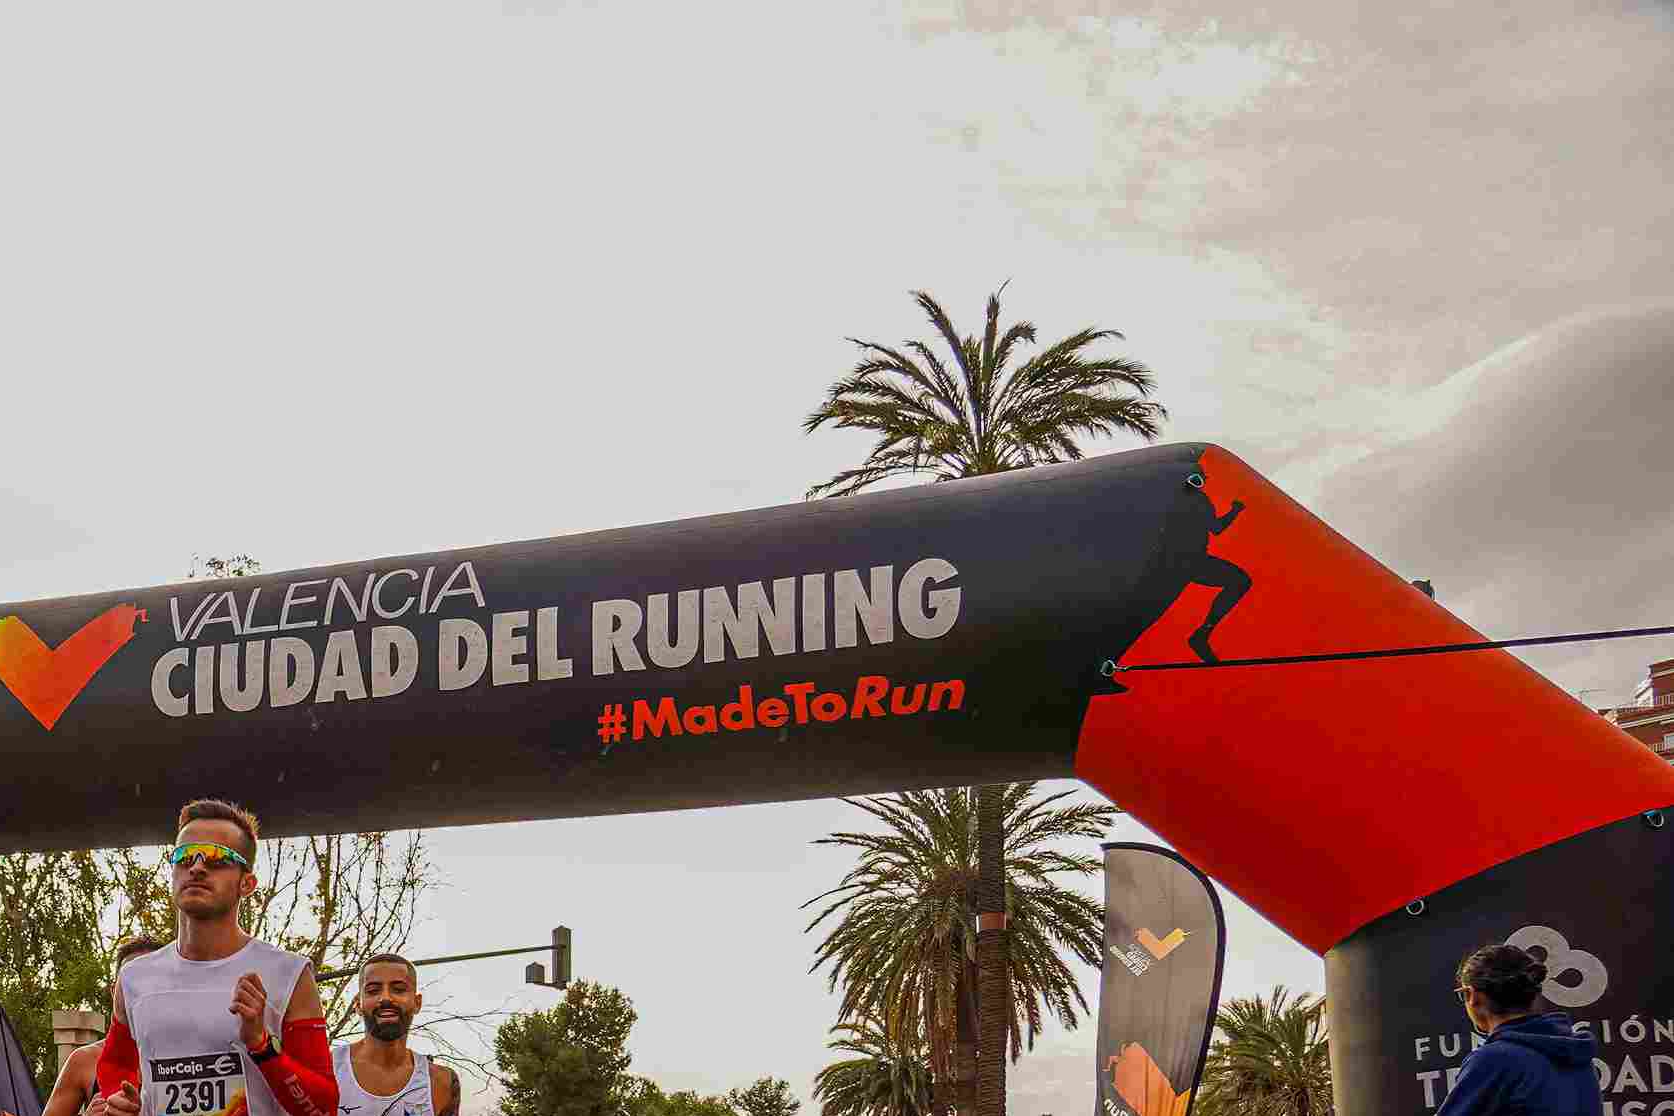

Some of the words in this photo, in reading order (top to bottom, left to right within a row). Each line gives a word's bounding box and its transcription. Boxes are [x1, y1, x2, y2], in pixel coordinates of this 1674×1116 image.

[150, 622, 420, 717] CIUDAD
[438, 606, 574, 691] DEL
[591, 557, 963, 677] RUNNING
[168, 560, 486, 643] VALENCIA
[596, 674, 967, 745] #MadeToRun
[165, 1079, 226, 1115] 2391
